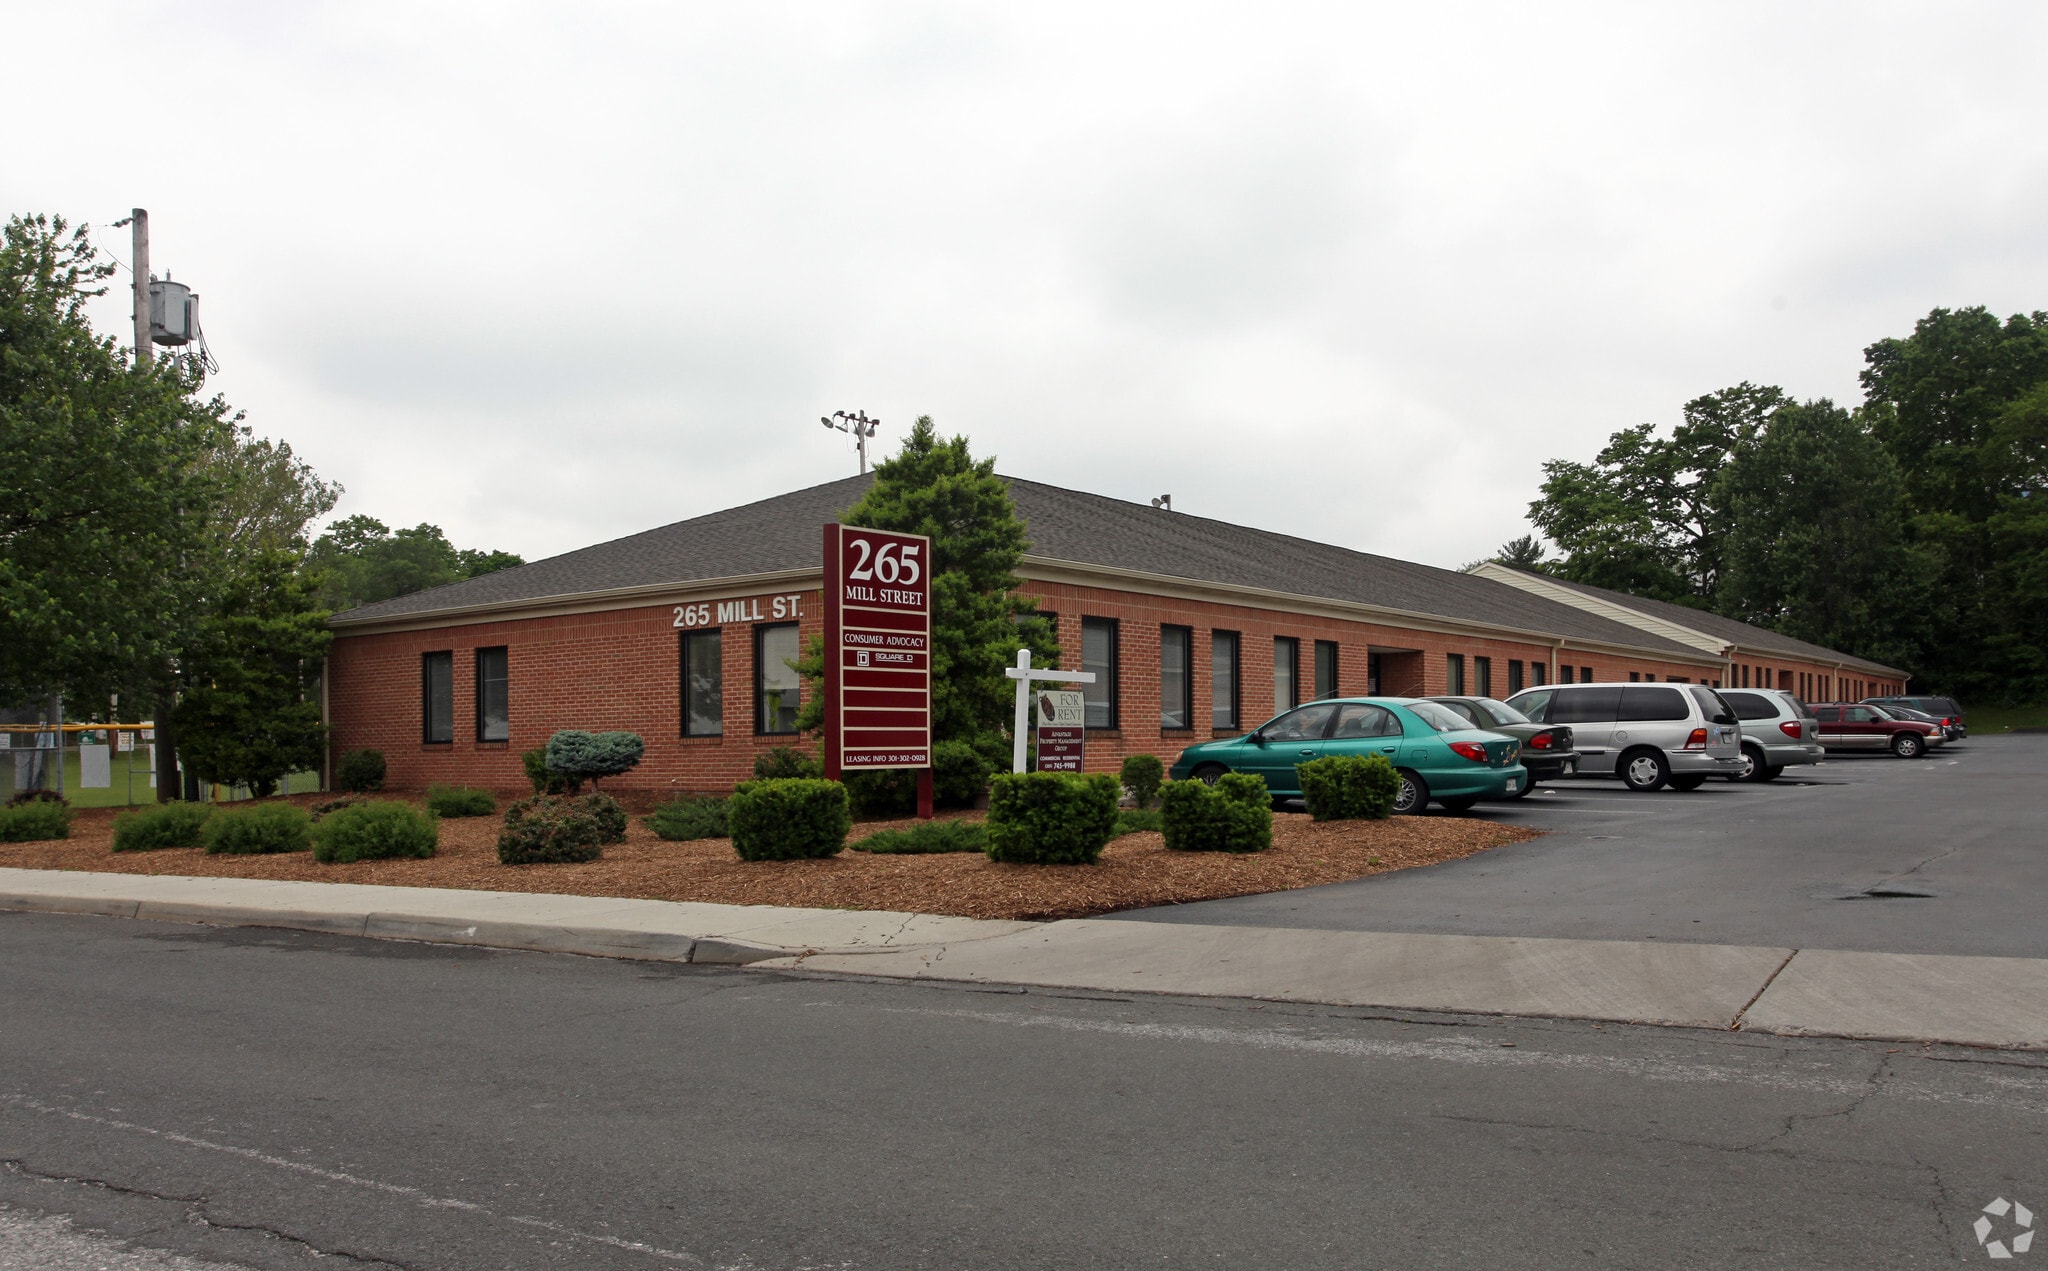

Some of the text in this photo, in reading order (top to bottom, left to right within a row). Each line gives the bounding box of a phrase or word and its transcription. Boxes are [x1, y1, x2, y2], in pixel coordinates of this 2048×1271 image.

[849, 539, 920, 586] 265
[846, 585, 923, 606] MILL STREET
[673, 595, 804, 628] 265 MILL ST.
[844, 633, 924, 648] CONSUMER ADVOCACY
[875, 652, 904, 661] SQUARE
[1060, 693, 1079, 706] FOR
[1058, 708, 1082, 721] RENT
[846, 755, 872, 763] LEASING
